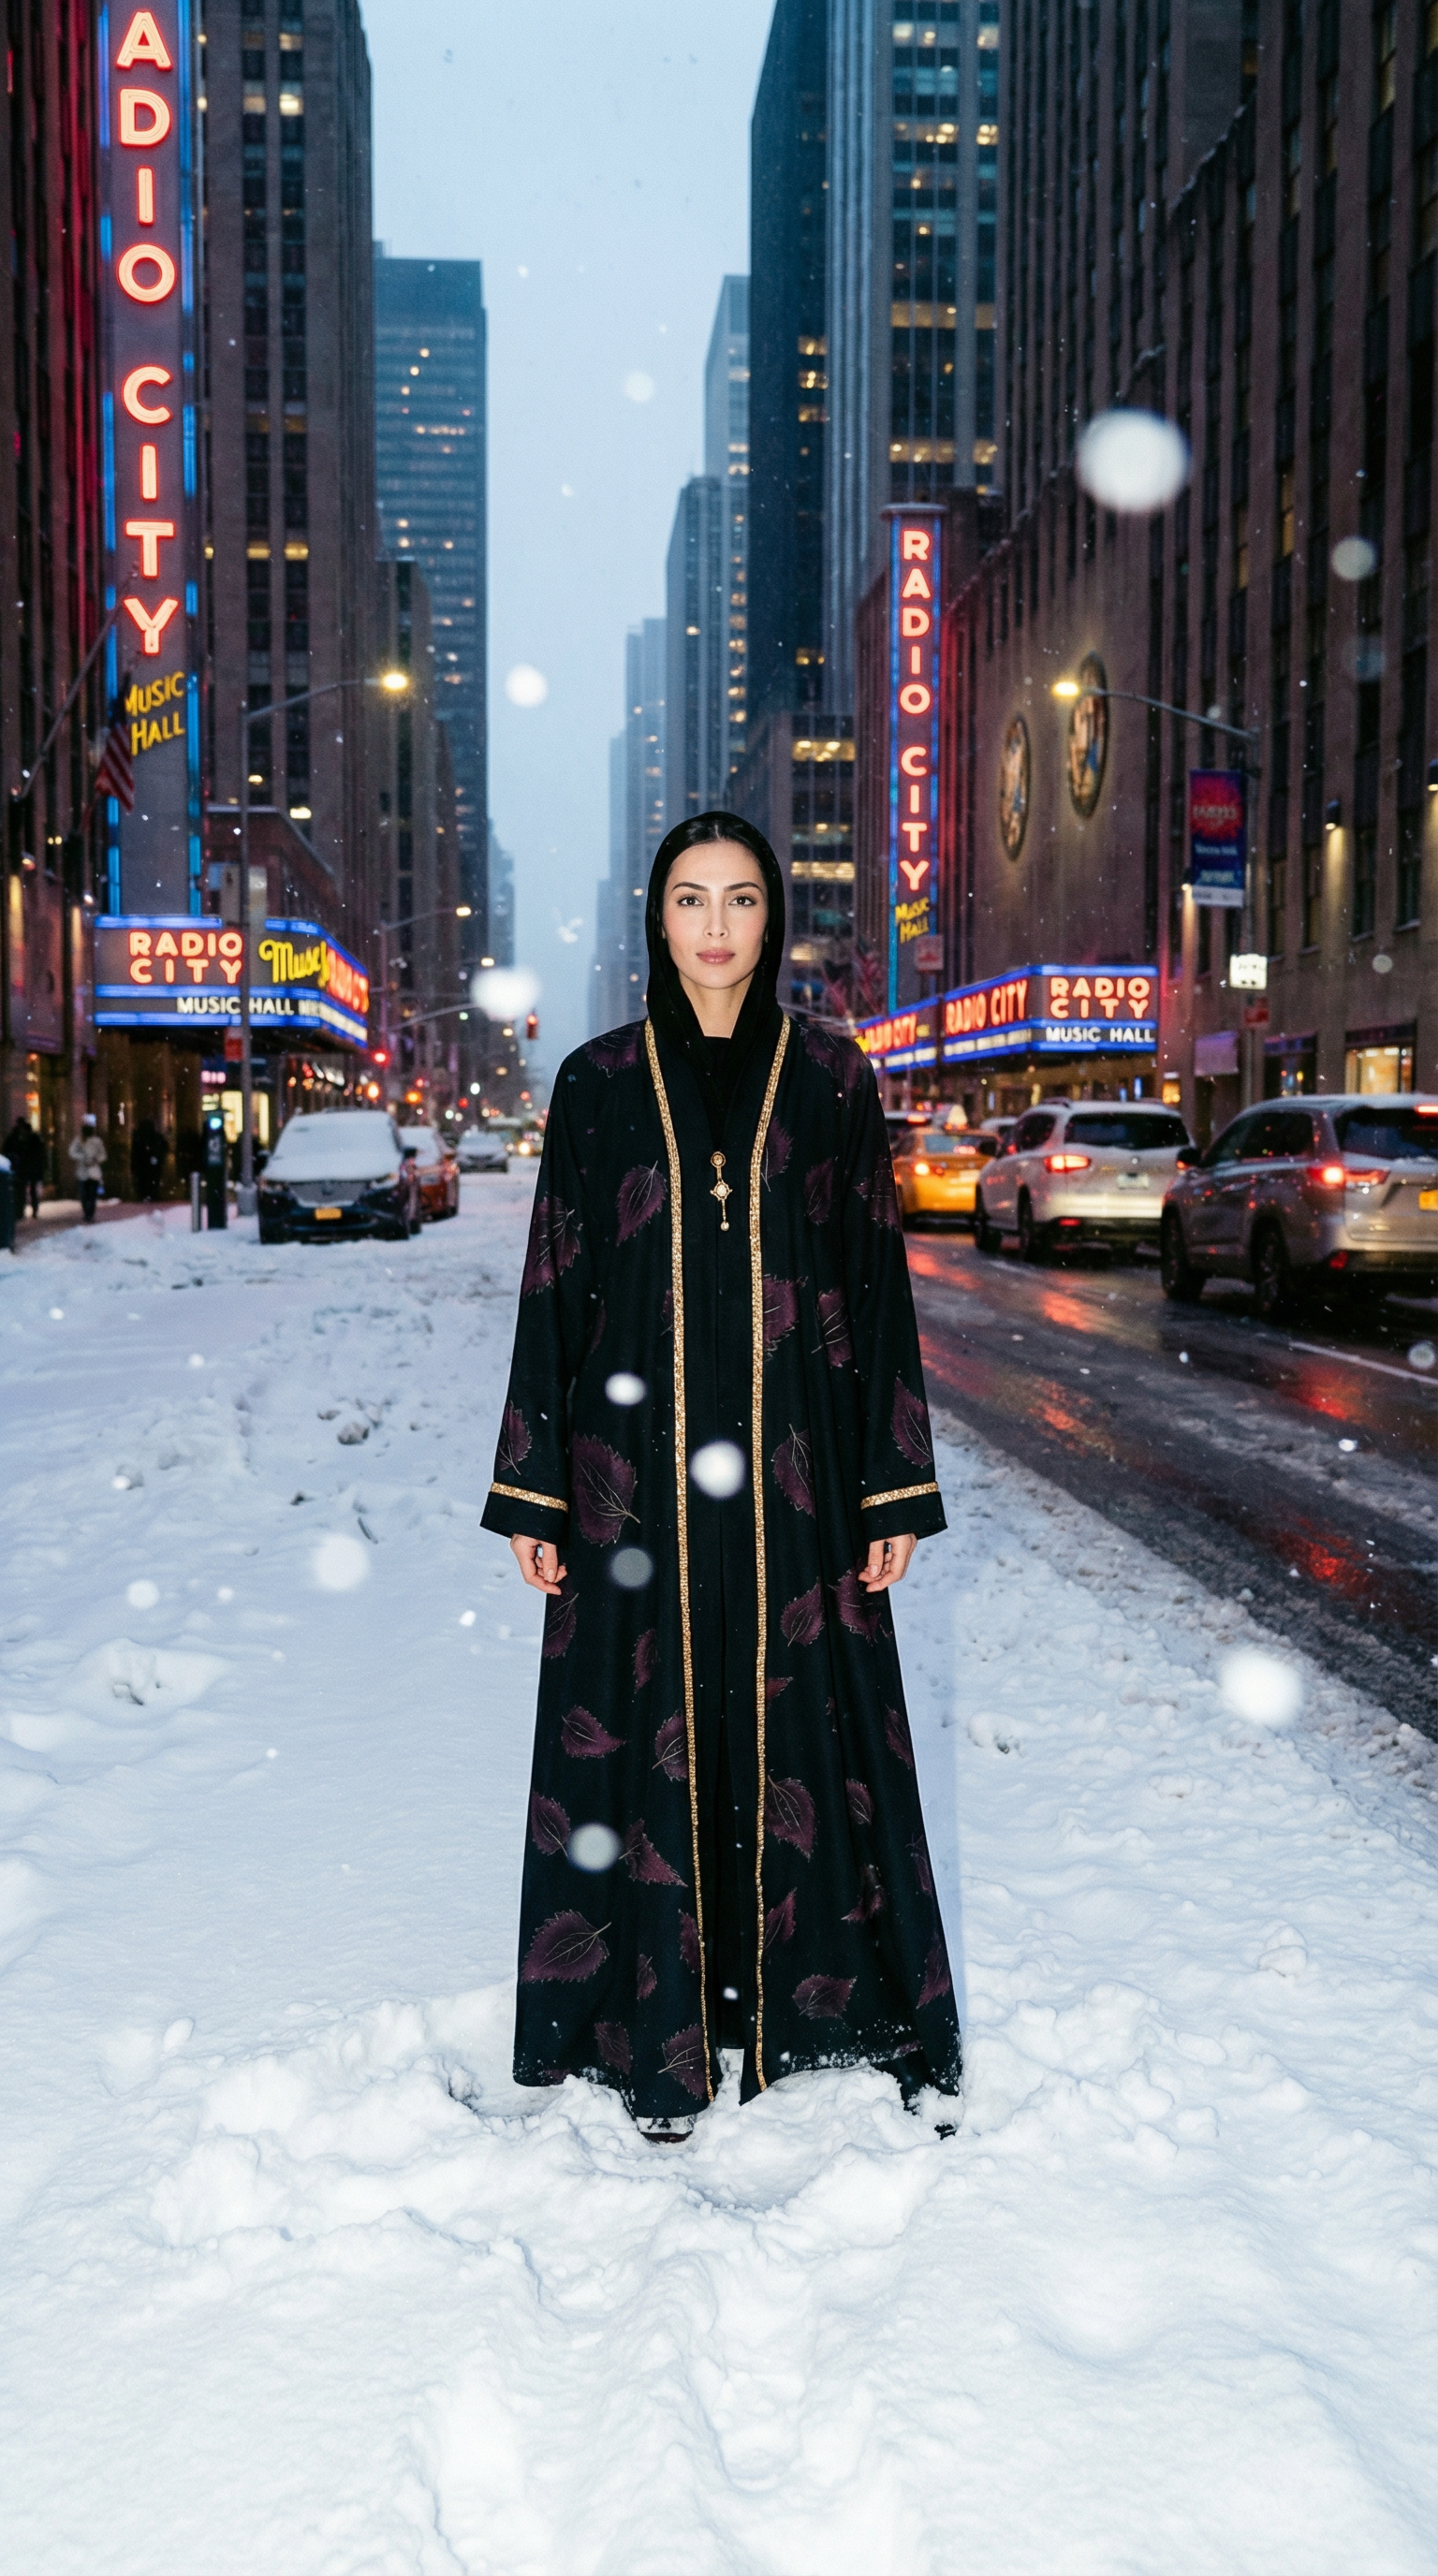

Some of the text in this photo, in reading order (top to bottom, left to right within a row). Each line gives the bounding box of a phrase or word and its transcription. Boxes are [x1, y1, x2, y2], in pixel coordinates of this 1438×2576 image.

[121, 363, 181, 656] CITY
[125, 670, 185, 717] MUSIC
[899, 529, 932, 892] RADIO CITY
[131, 710, 185, 756] HALL
[128, 930, 243, 958] RADIO
[128, 958, 242, 984] CITY
[1049, 976, 1151, 999] RADIO
[176, 996, 295, 1016] MUSIC HALL
[946, 979, 1027, 1035] RADIO CITY
[1049, 997, 1149, 1019] CITY
[1045, 1026, 1102, 1044] MUSIC
[1108, 1026, 1156, 1044] HALL
